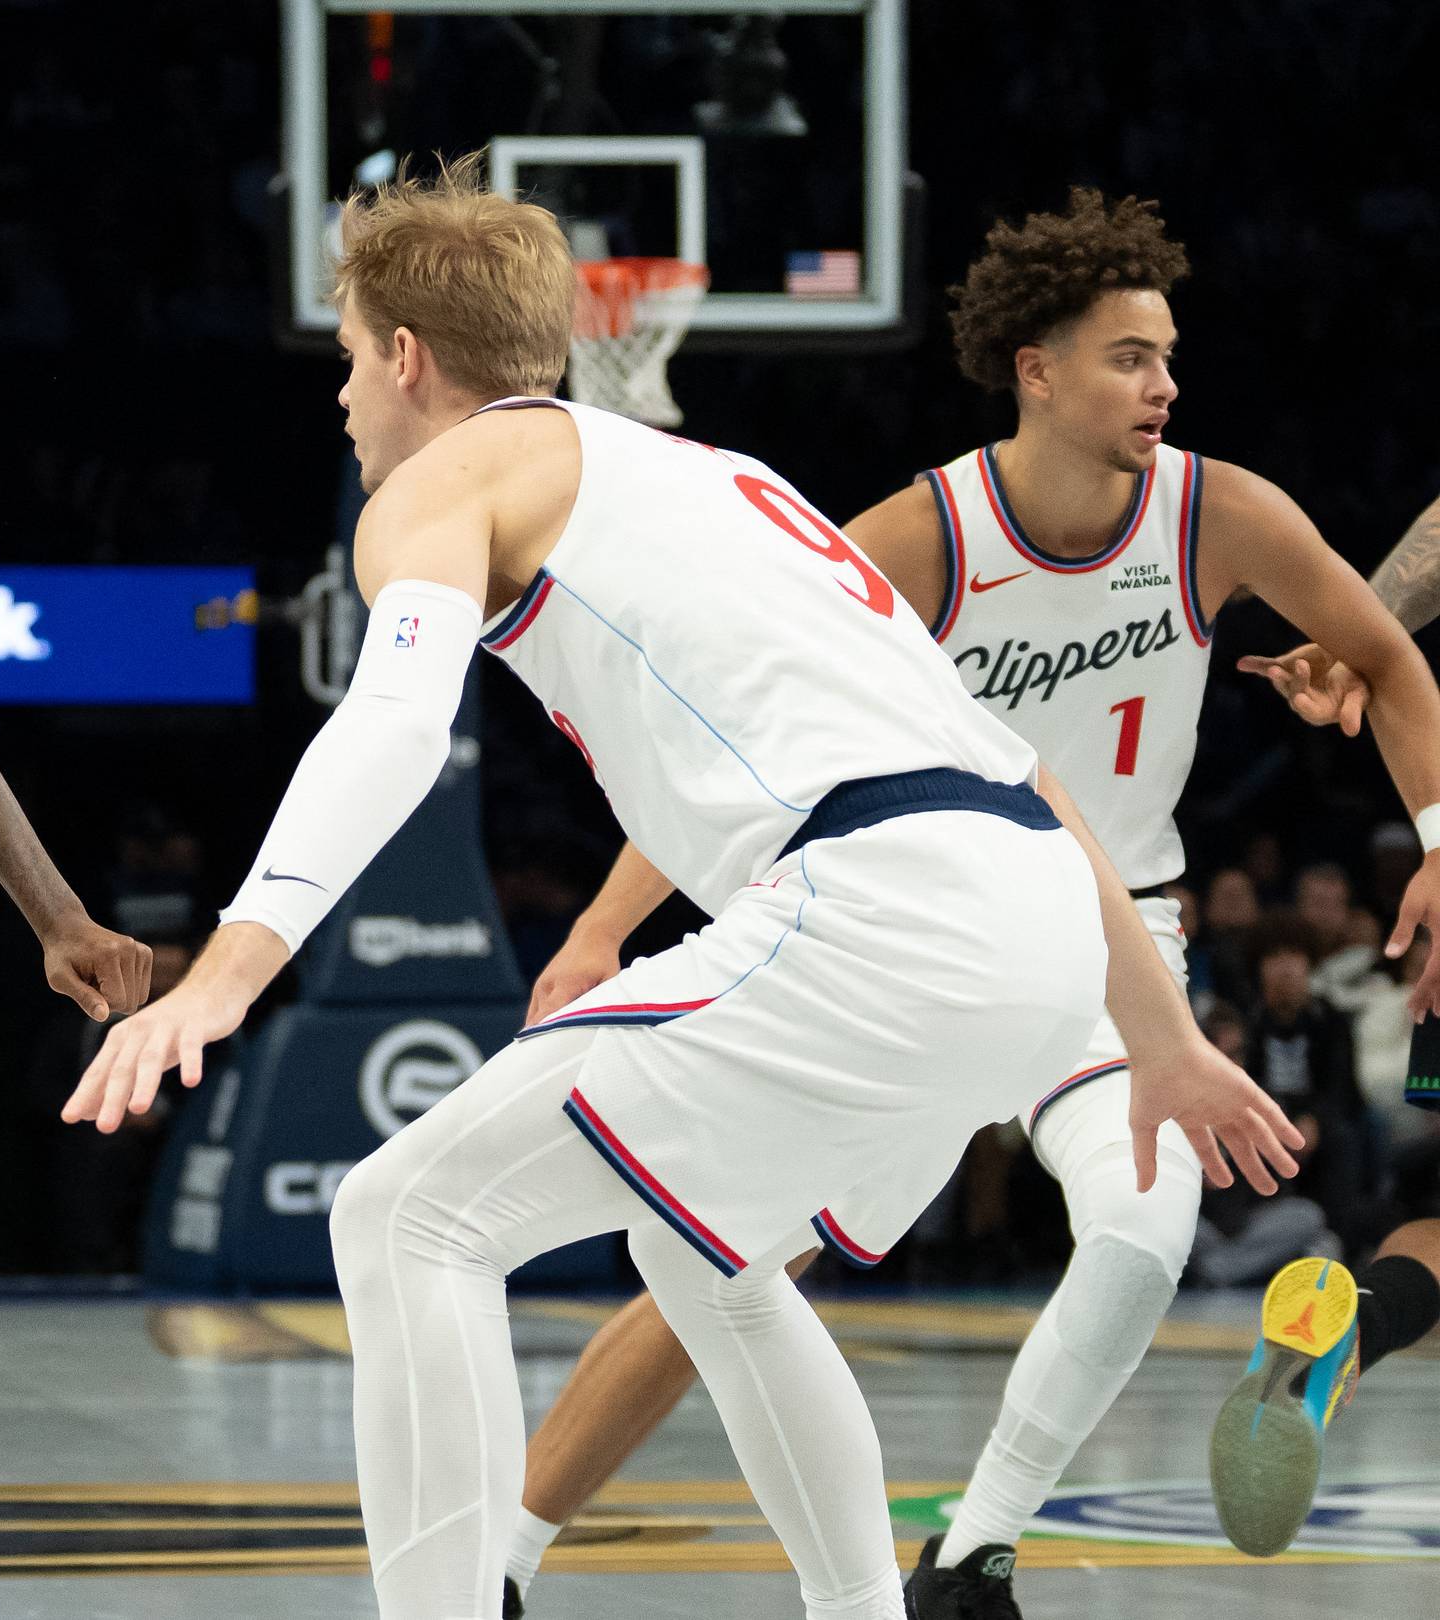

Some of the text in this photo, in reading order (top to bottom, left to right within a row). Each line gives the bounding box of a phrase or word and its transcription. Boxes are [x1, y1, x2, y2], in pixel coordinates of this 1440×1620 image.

[732, 473, 895, 620] 9
[1110, 574, 1173, 592] RWANDA
[1122, 563, 1160, 577] VISIT
[955, 607, 1182, 711] Clippers
[1108, 695, 1147, 777] 1
